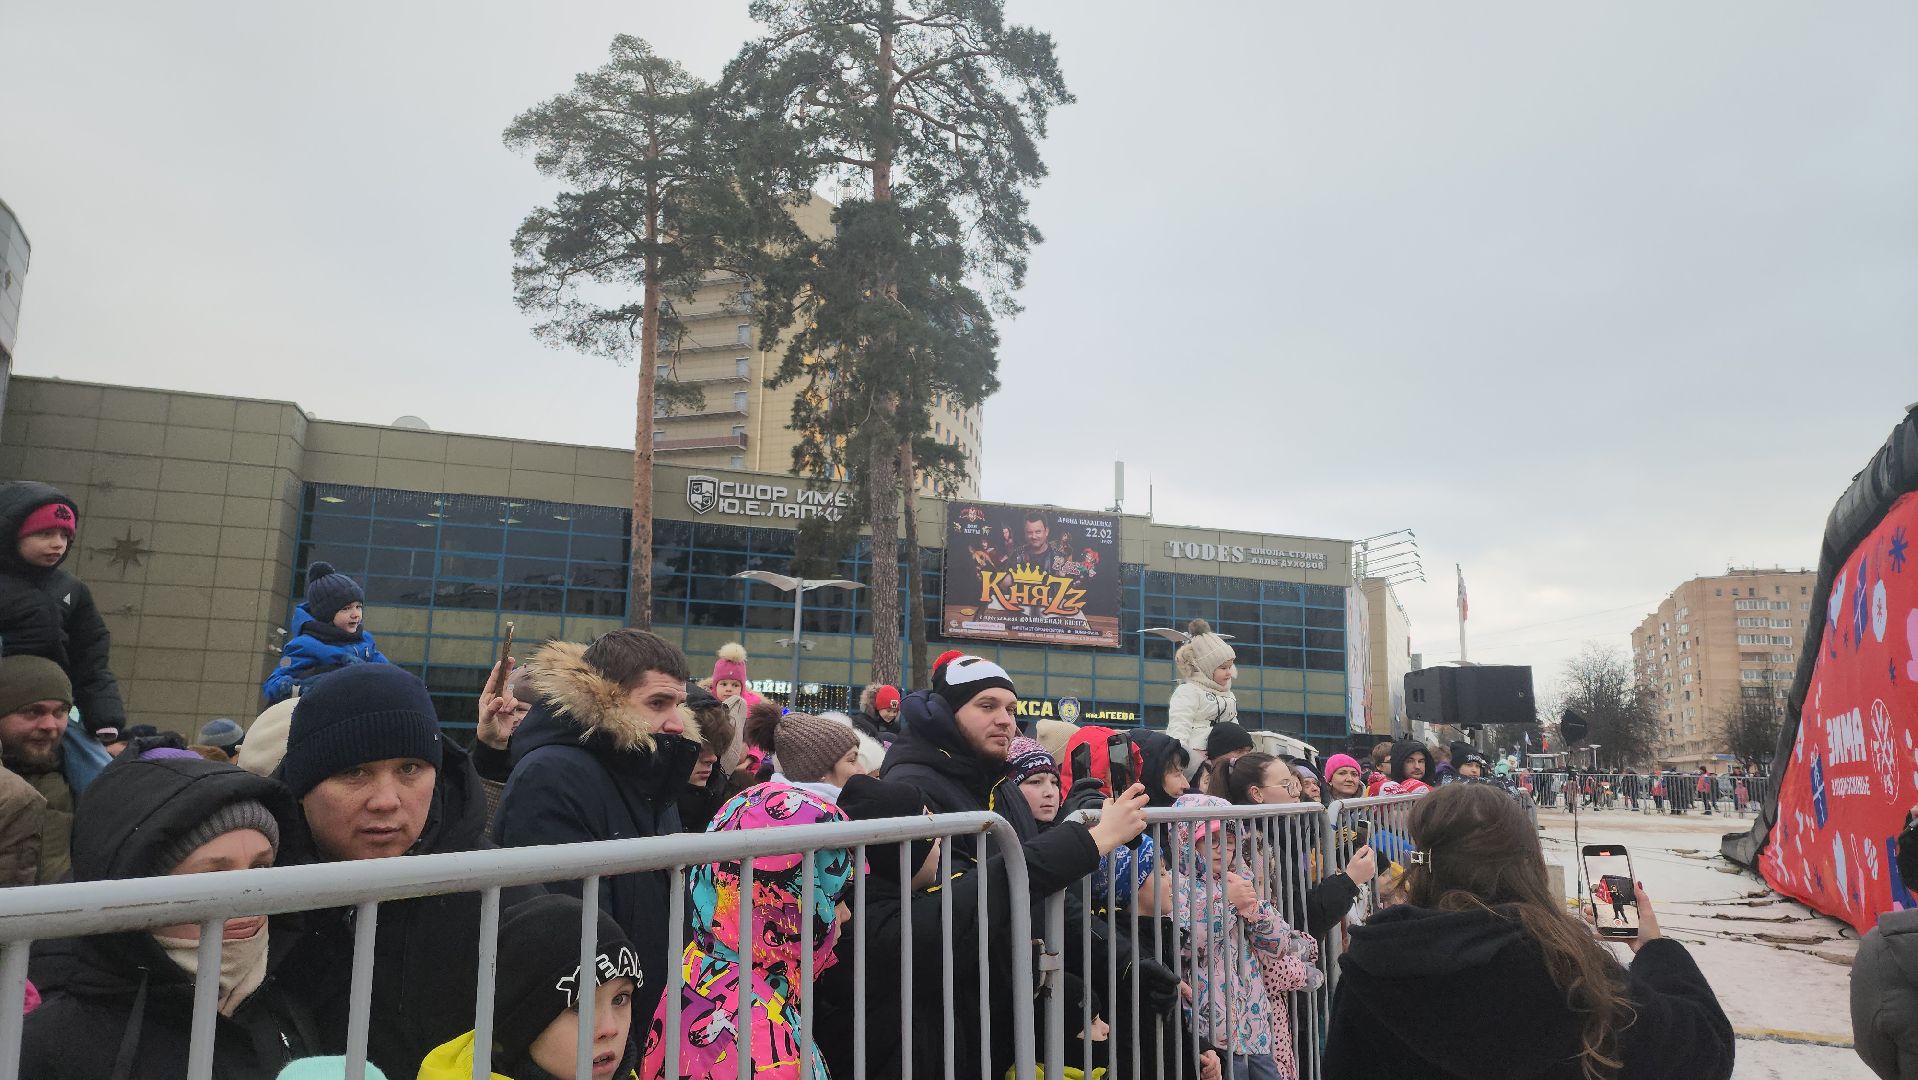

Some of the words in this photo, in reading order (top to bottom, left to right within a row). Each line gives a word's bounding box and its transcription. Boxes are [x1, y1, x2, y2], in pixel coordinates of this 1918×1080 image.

[718, 481, 788, 501] СШОР
[1085, 527, 1113, 539] 22.02
[1168, 540, 1245, 563] TODES
[1250, 547, 1285, 557] ШКОЛА
[1289, 550, 1324, 561] СТУДИЯ
[1251, 557, 1278, 566] АЛЛЫ
[1280, 559, 1324, 570] ДУХОВОЙ
[1017, 700, 1053, 717] КСА
[1826, 706, 1867, 768] ЗИМА
